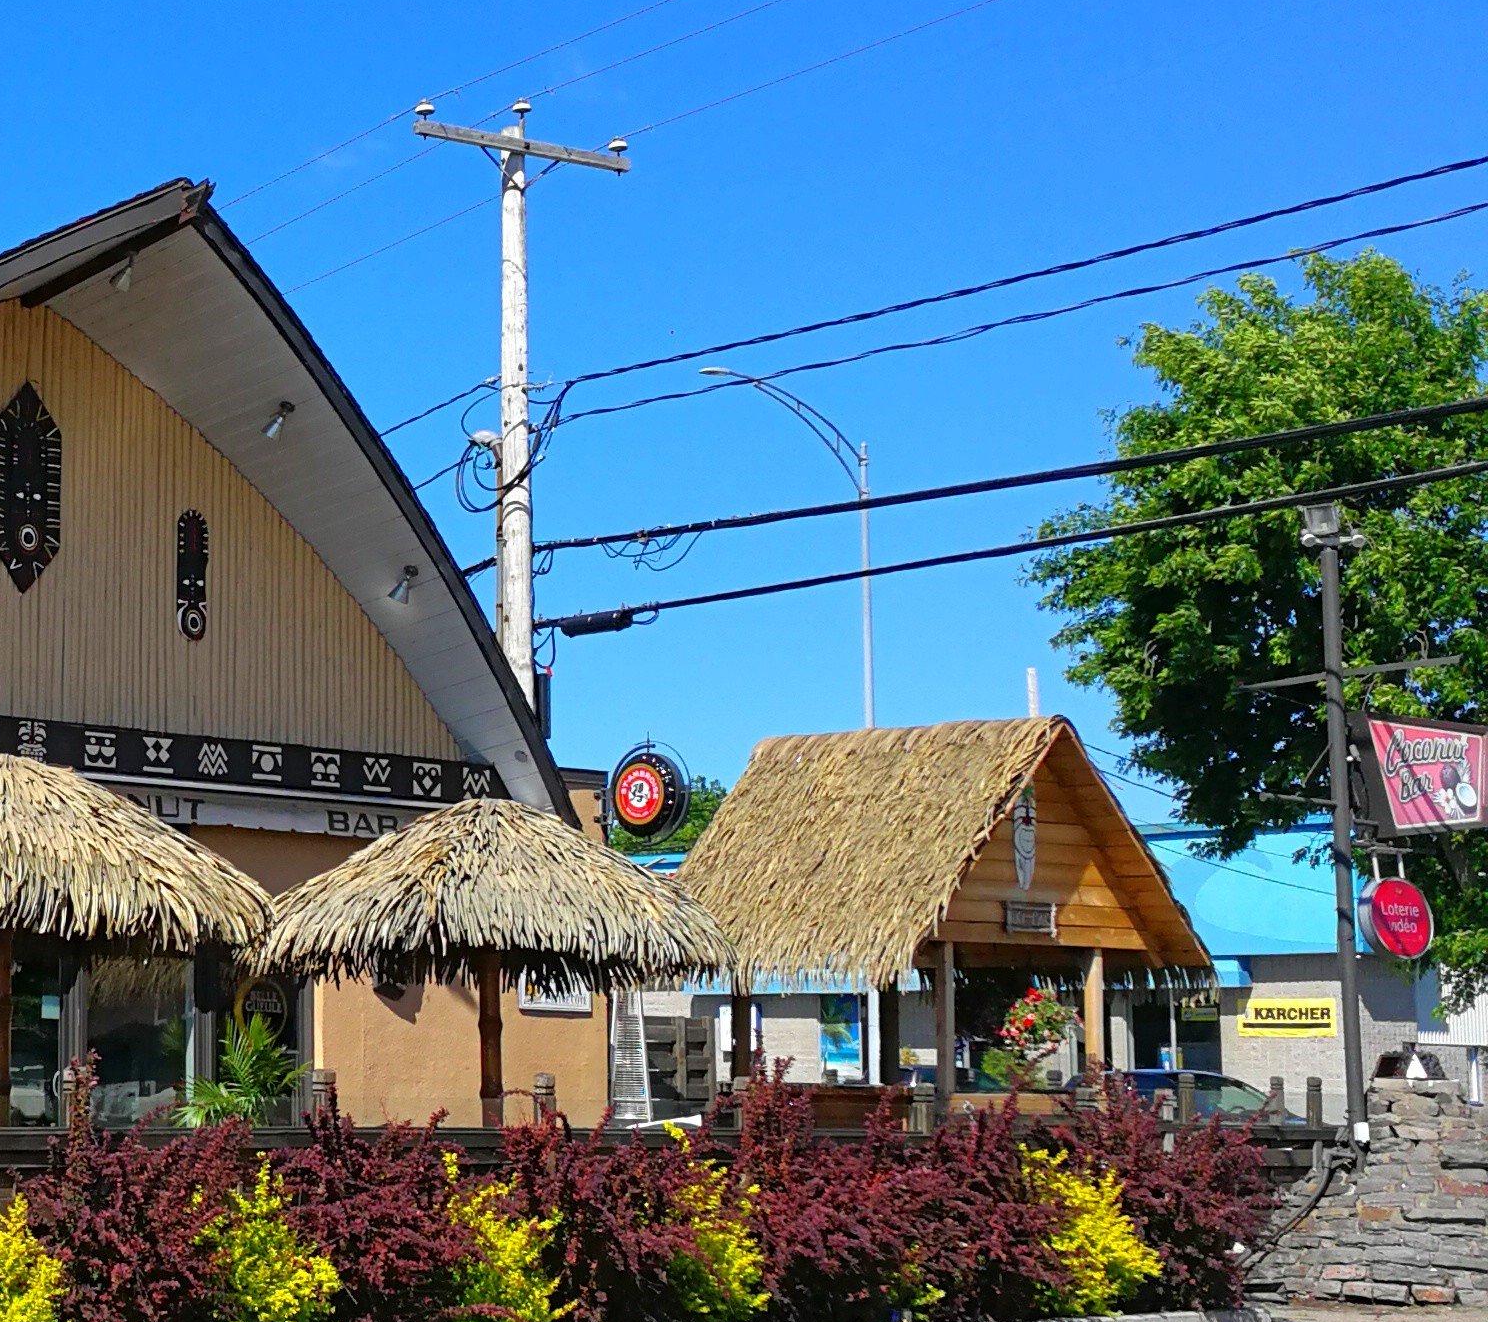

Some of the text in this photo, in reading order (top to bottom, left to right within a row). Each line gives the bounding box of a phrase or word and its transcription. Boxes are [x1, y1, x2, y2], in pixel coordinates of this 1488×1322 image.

[1385, 729, 1468, 776] Coconut
[1399, 767, 1433, 803] Bar
[1380, 901, 1420, 917] Loterie
[1388, 918, 1418, 933] vidéo
